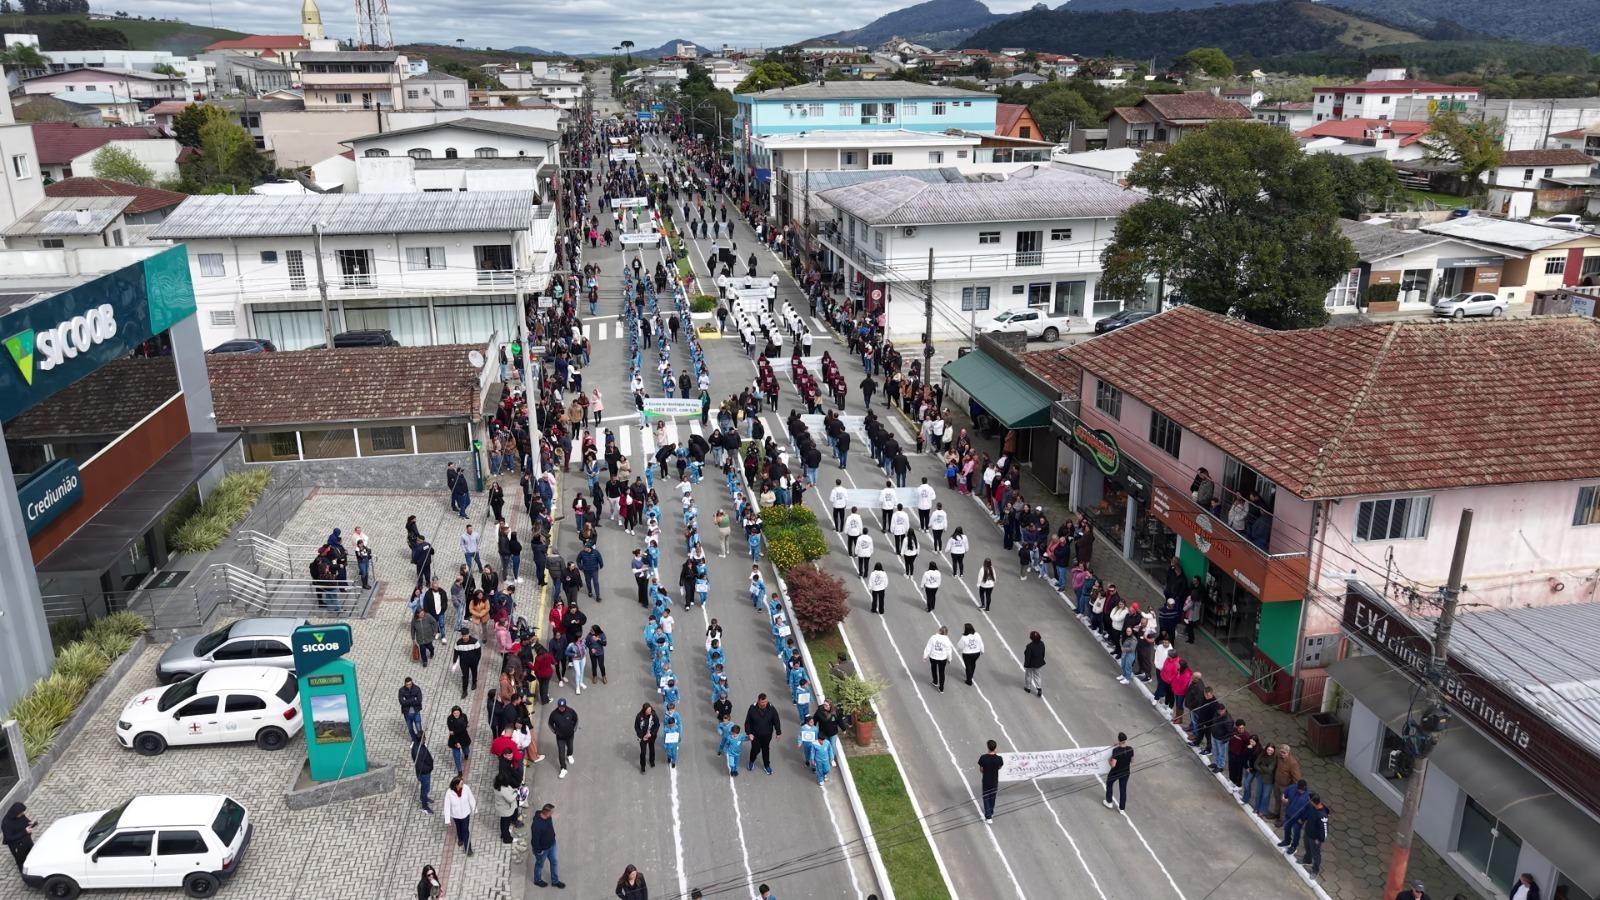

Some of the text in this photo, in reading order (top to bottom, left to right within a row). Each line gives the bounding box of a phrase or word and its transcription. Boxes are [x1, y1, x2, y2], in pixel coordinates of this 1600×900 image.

[36, 303, 117, 371] SICOOB
[27, 474, 78, 521] Crediunião
[302, 642, 340, 653] SICOOB
[1441, 678, 1530, 749] eterinária
